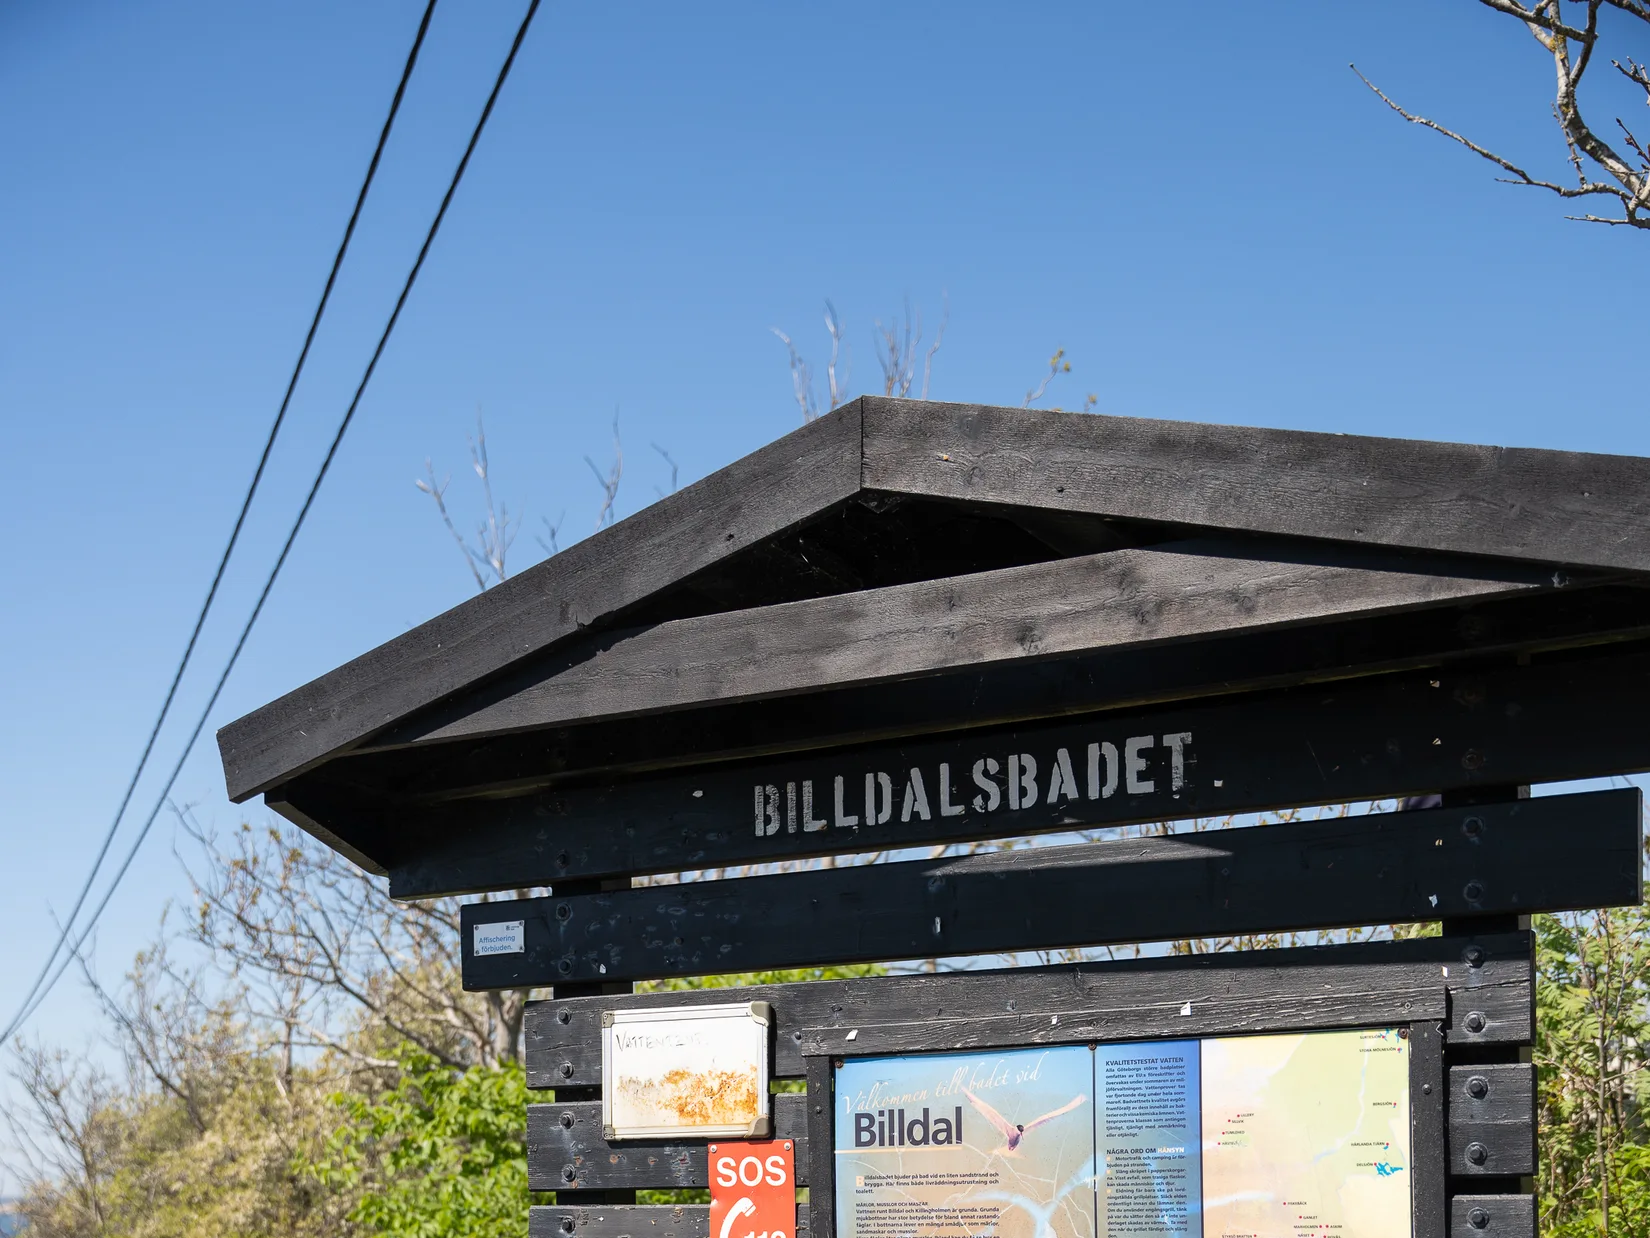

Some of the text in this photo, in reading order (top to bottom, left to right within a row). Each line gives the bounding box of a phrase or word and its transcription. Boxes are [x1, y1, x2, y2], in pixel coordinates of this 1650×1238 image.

[755, 732, 1192, 836] BILLDALSBADET
[479, 935, 515, 943] Affischering
[481, 944, 512, 952] förbjuden.
[1106, 1058, 1158, 1066] KVALITETSTESTAT
[844, 1051, 1049, 1114] Välkommen till badet vid
[855, 1106, 963, 1148] Billdal
[717, 1156, 786, 1187] SOS
